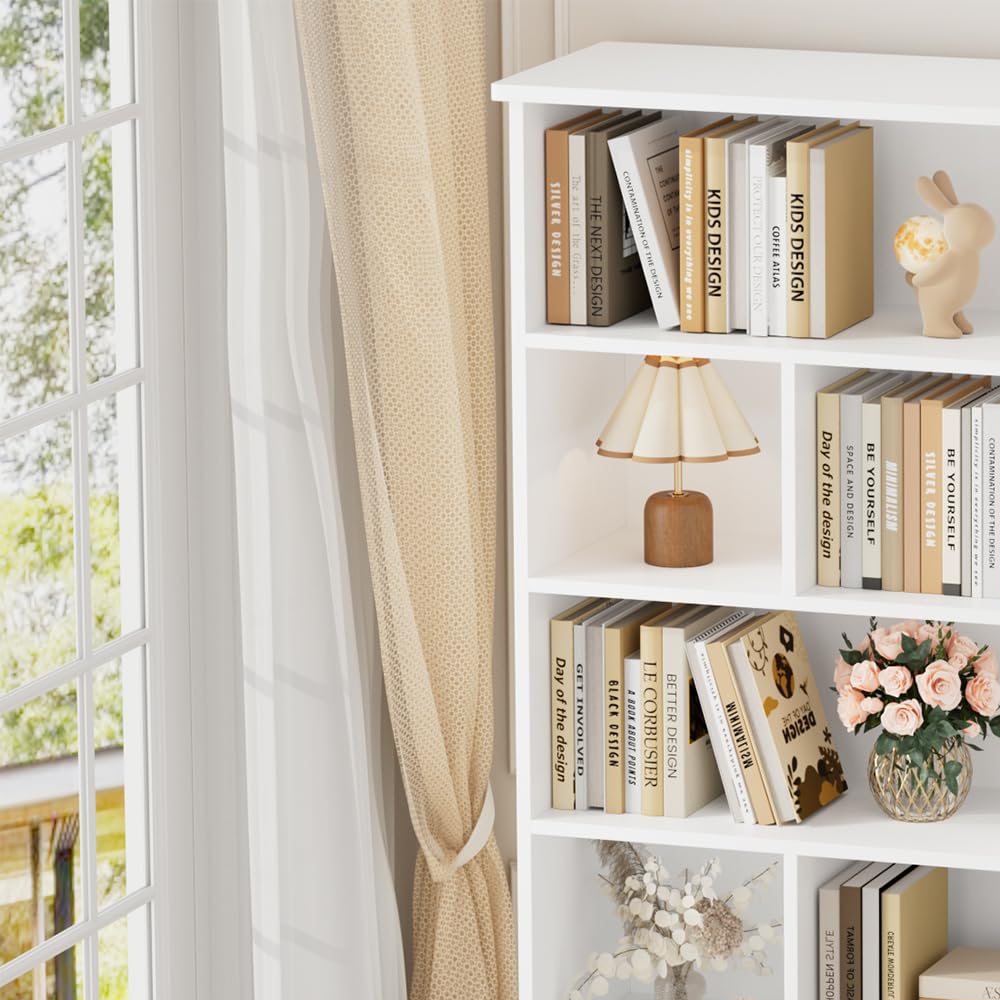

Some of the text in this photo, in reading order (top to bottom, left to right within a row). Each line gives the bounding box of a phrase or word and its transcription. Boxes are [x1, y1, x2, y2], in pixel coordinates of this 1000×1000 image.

[684, 149, 692, 200] simplicity
[550, 182, 562, 277] SILVER DESIGN
[591, 196, 603, 317] THE NEXT DESIGN
[623, 171, 663, 299] CONTAMINATION OF THE DESIGN
[708, 189, 721, 297] KIDS DESIGN
[772, 225, 780, 288] COFFEE ATLAS
[790, 193, 804, 302] KIDS DESIGN
[821, 430, 834, 559] Day of the design
[846, 445, 854, 475] SPACE
[866, 443, 876, 545] BE YOURSELF
[925, 452, 936, 548] SILVER DESIGN
[947, 448, 956, 551] BE YOURSELF
[989, 509, 995, 518] OF
[555, 657, 568, 783] Day of the design
[576, 663, 584, 692] GET
[608, 680, 619, 767] BLACK DESIGN
[628, 699, 636, 723] BOOK
[643, 662, 658, 788] LE CORBUSIER
[628, 724, 636, 753] ABOUT
[628, 755, 636, 786] POINTS
[667, 674, 677, 779] BETTER DESIGN
